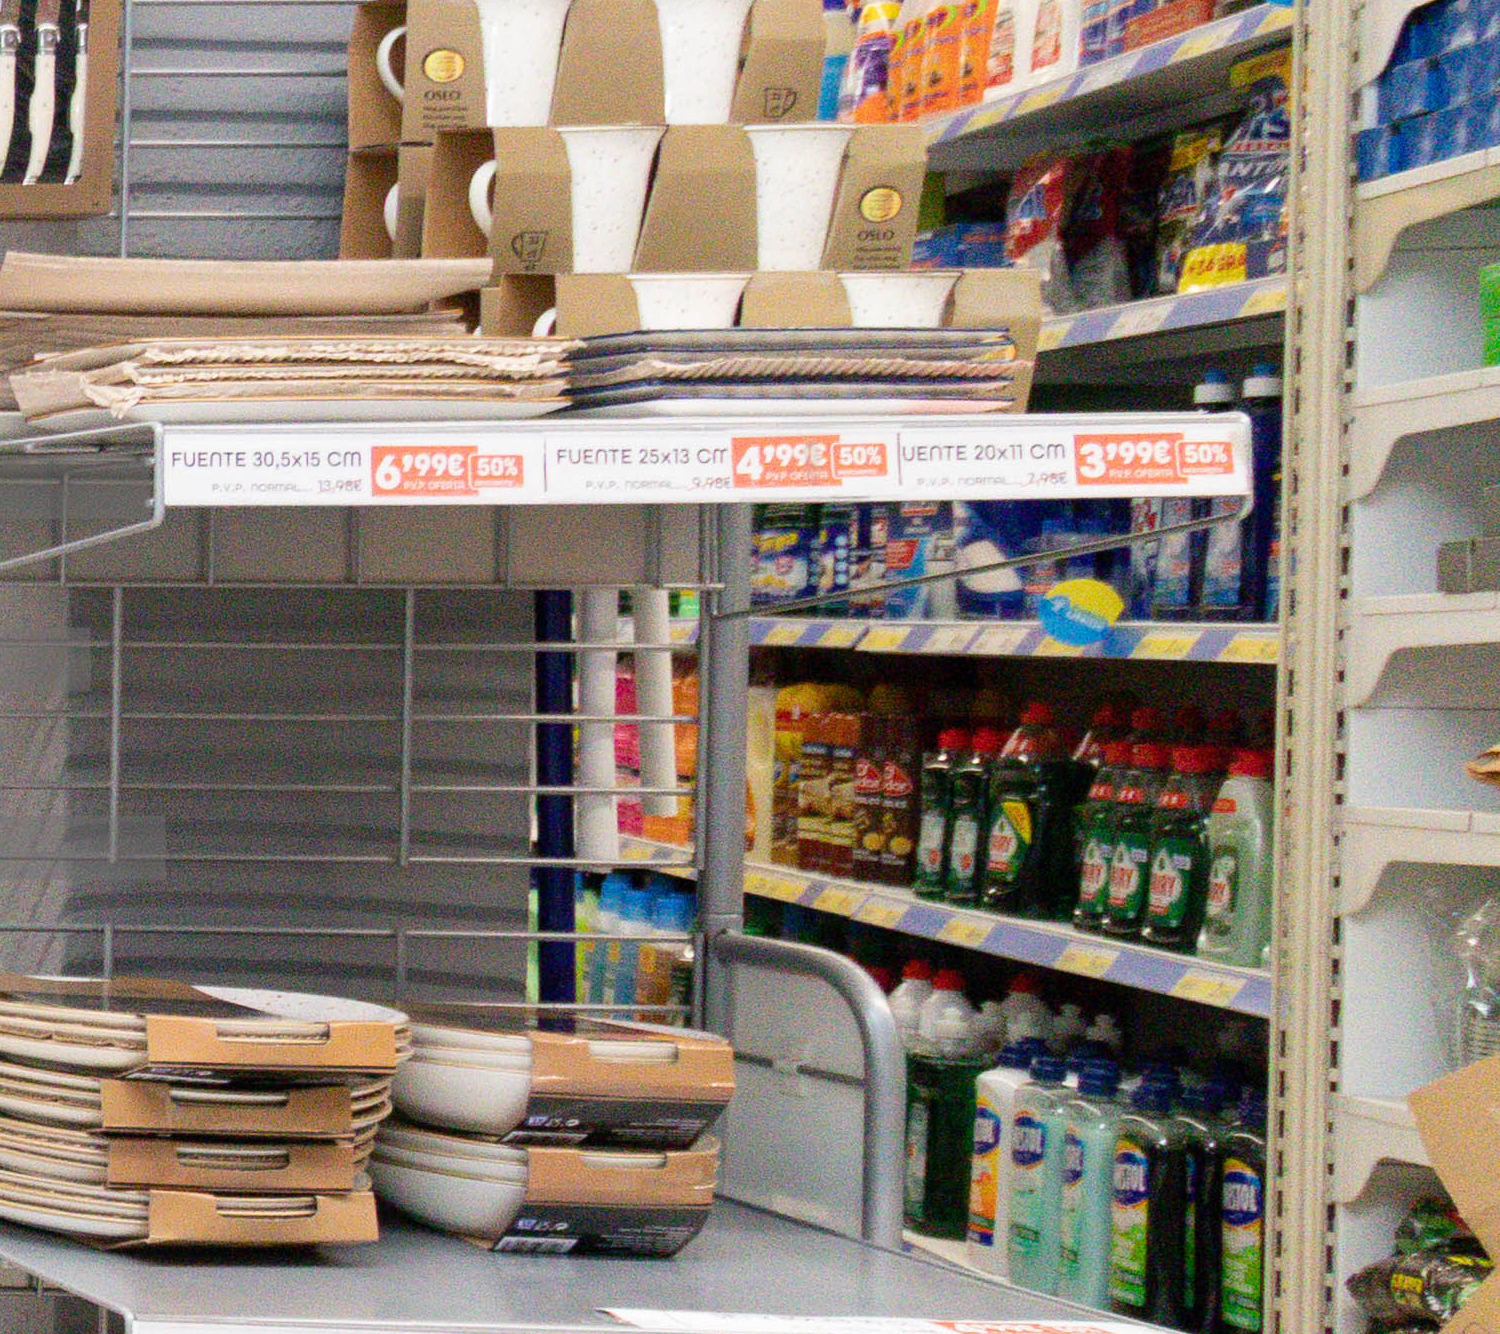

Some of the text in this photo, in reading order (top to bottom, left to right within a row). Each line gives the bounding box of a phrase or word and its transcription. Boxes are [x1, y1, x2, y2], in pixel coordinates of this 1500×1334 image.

[171, 450, 363, 470] FUENTE 30,5x15 CM
[556, 447, 728, 466] FUENTE 25x13 CM
[838, 446, 882, 467] 50%
[902, 442, 1066, 462] UENTE 20x11 CM
[1184, 442, 1230, 465] 50%
[477, 456, 518, 478] 50%
